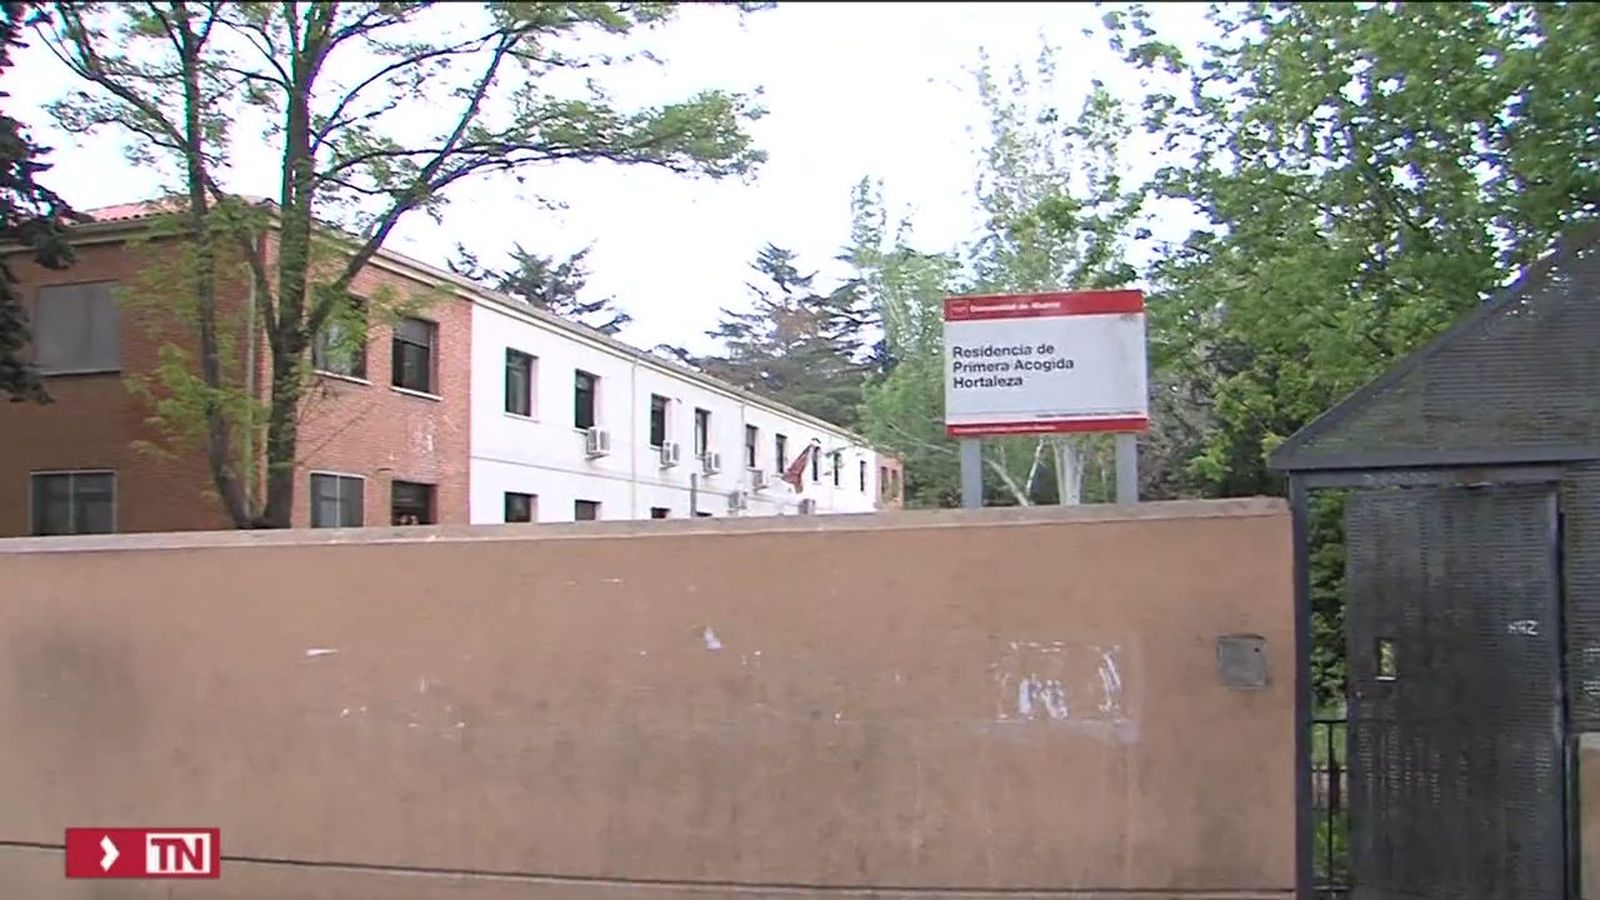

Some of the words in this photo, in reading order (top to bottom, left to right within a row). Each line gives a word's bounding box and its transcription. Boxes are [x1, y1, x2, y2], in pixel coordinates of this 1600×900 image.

[953, 345, 1032, 358] Residencia
[1037, 344, 1055, 355] de
[953, 361, 1010, 373] Primera
[1013, 358, 1074, 372] Acogida
[953, 375, 1023, 388] Hortaleza
